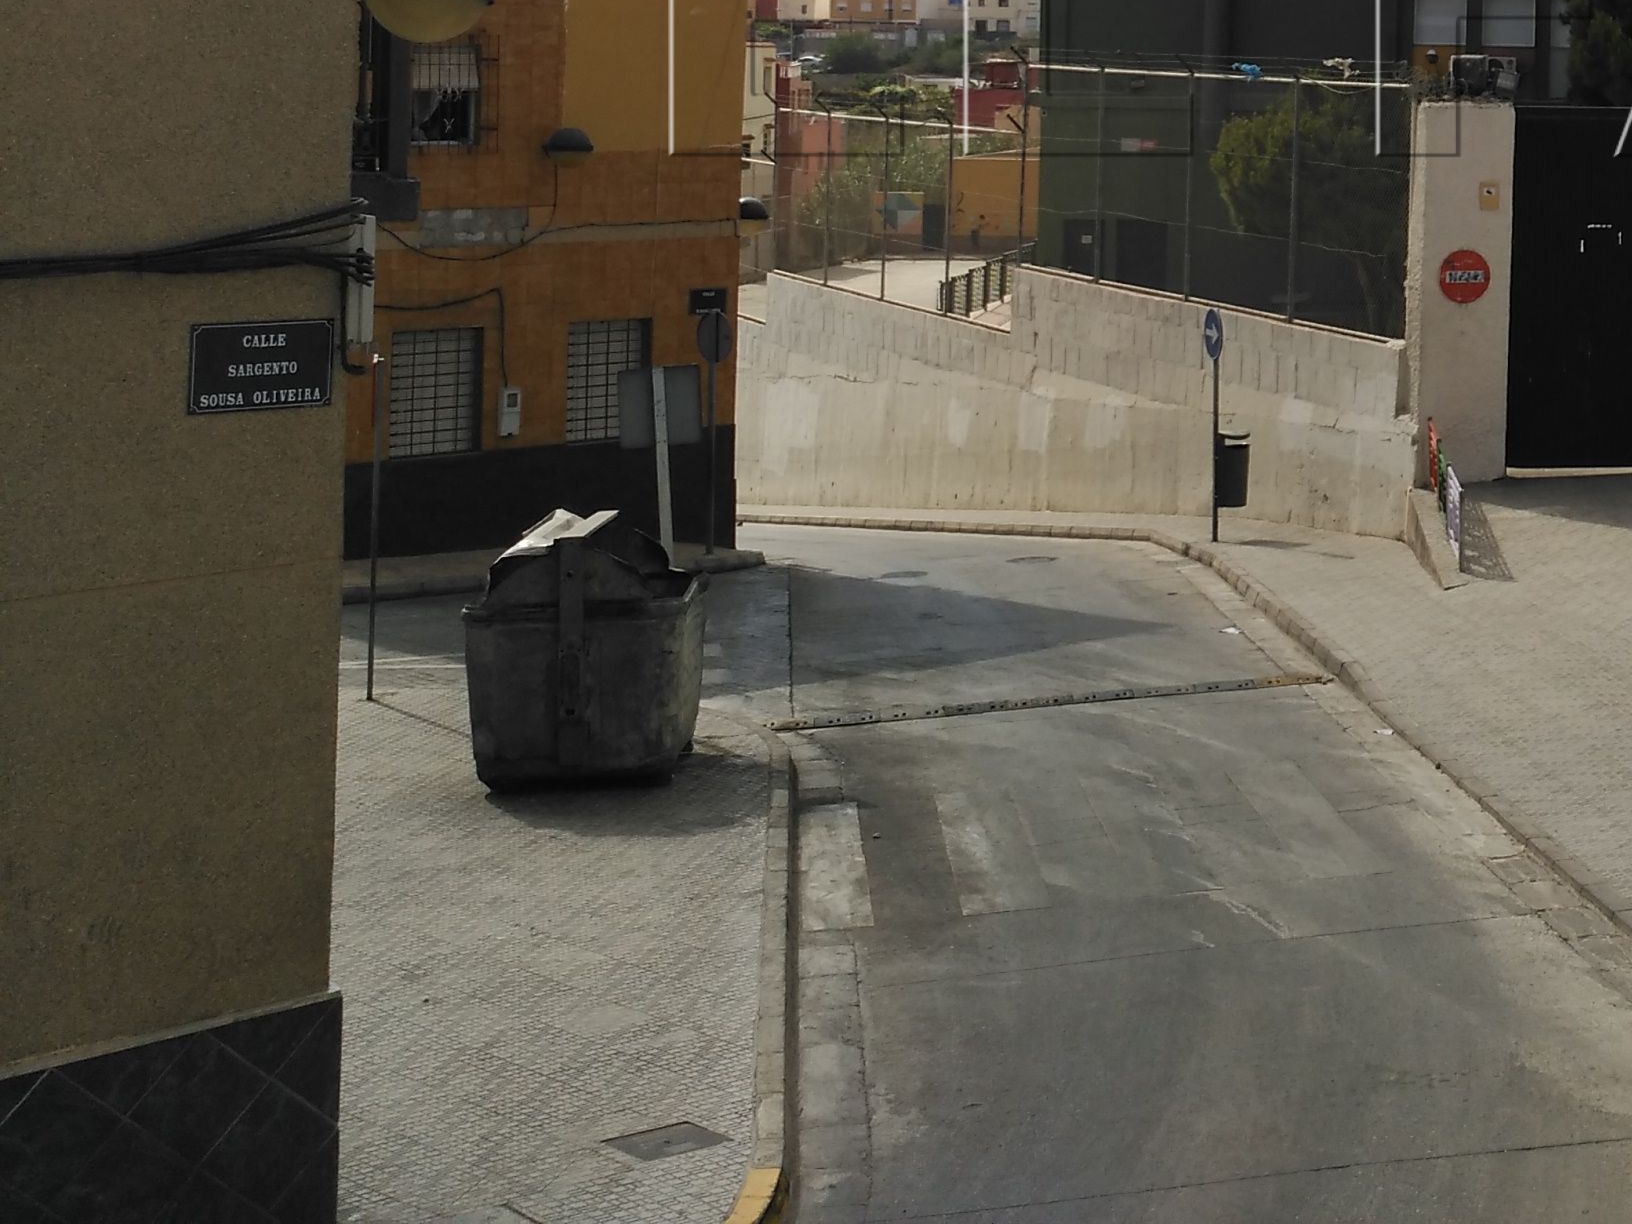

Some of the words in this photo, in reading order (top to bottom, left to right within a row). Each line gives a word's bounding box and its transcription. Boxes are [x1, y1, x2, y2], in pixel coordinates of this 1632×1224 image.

[242, 333, 287, 348] CALLE
[227, 361, 298, 377] SARGENTO
[200, 392, 244, 408] SOUSA
[253, 387, 321, 404] OLIVEIRA
